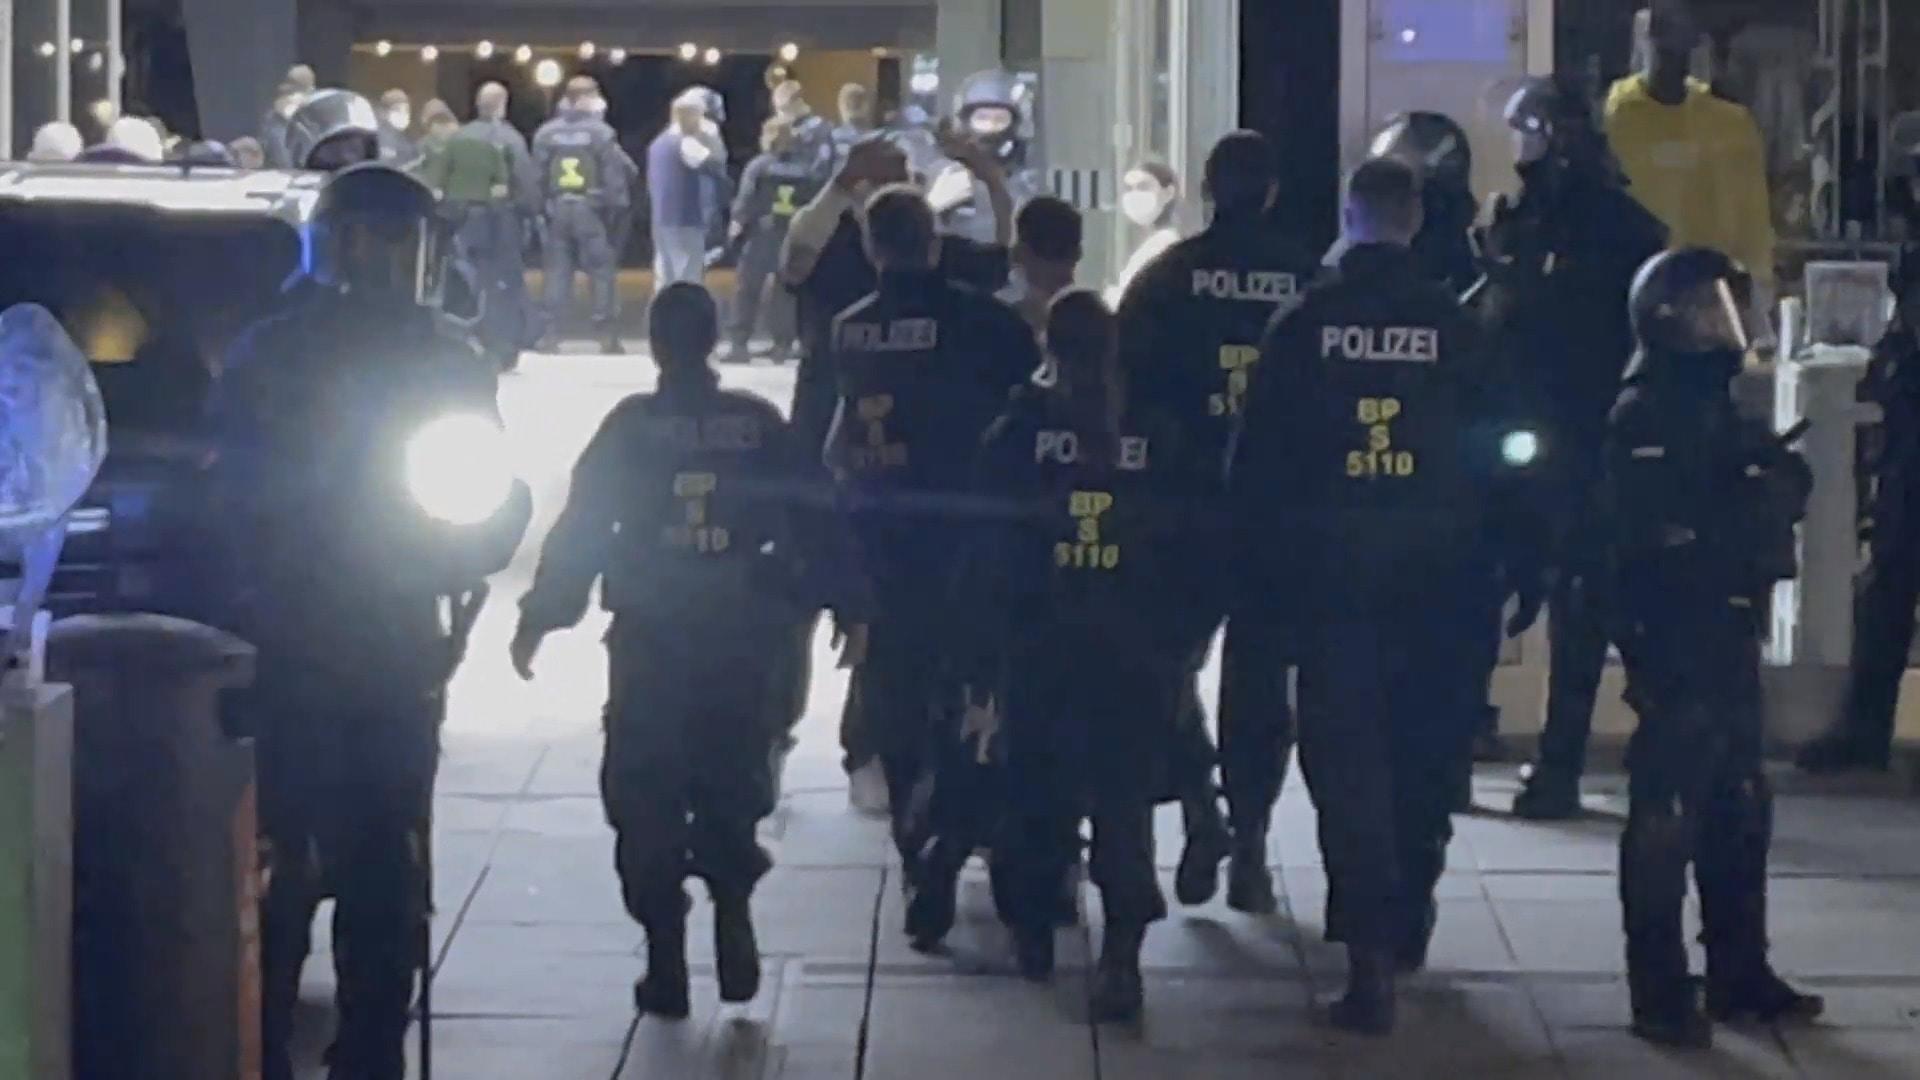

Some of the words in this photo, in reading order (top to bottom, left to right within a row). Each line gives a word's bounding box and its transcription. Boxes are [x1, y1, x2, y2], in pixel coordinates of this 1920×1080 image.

[1191, 269, 1296, 302] POLIZEI
[1321, 325, 1438, 362] POLIZEI
[1357, 397, 1401, 424] BP
[1035, 431, 1148, 470] POEI
[1369, 424, 1390, 451] S
[1346, 450, 1414, 477] 5110
[1069, 490, 1113, 516] BP
[1078, 517, 1099, 541] S
[1054, 542, 1119, 568] 5110
